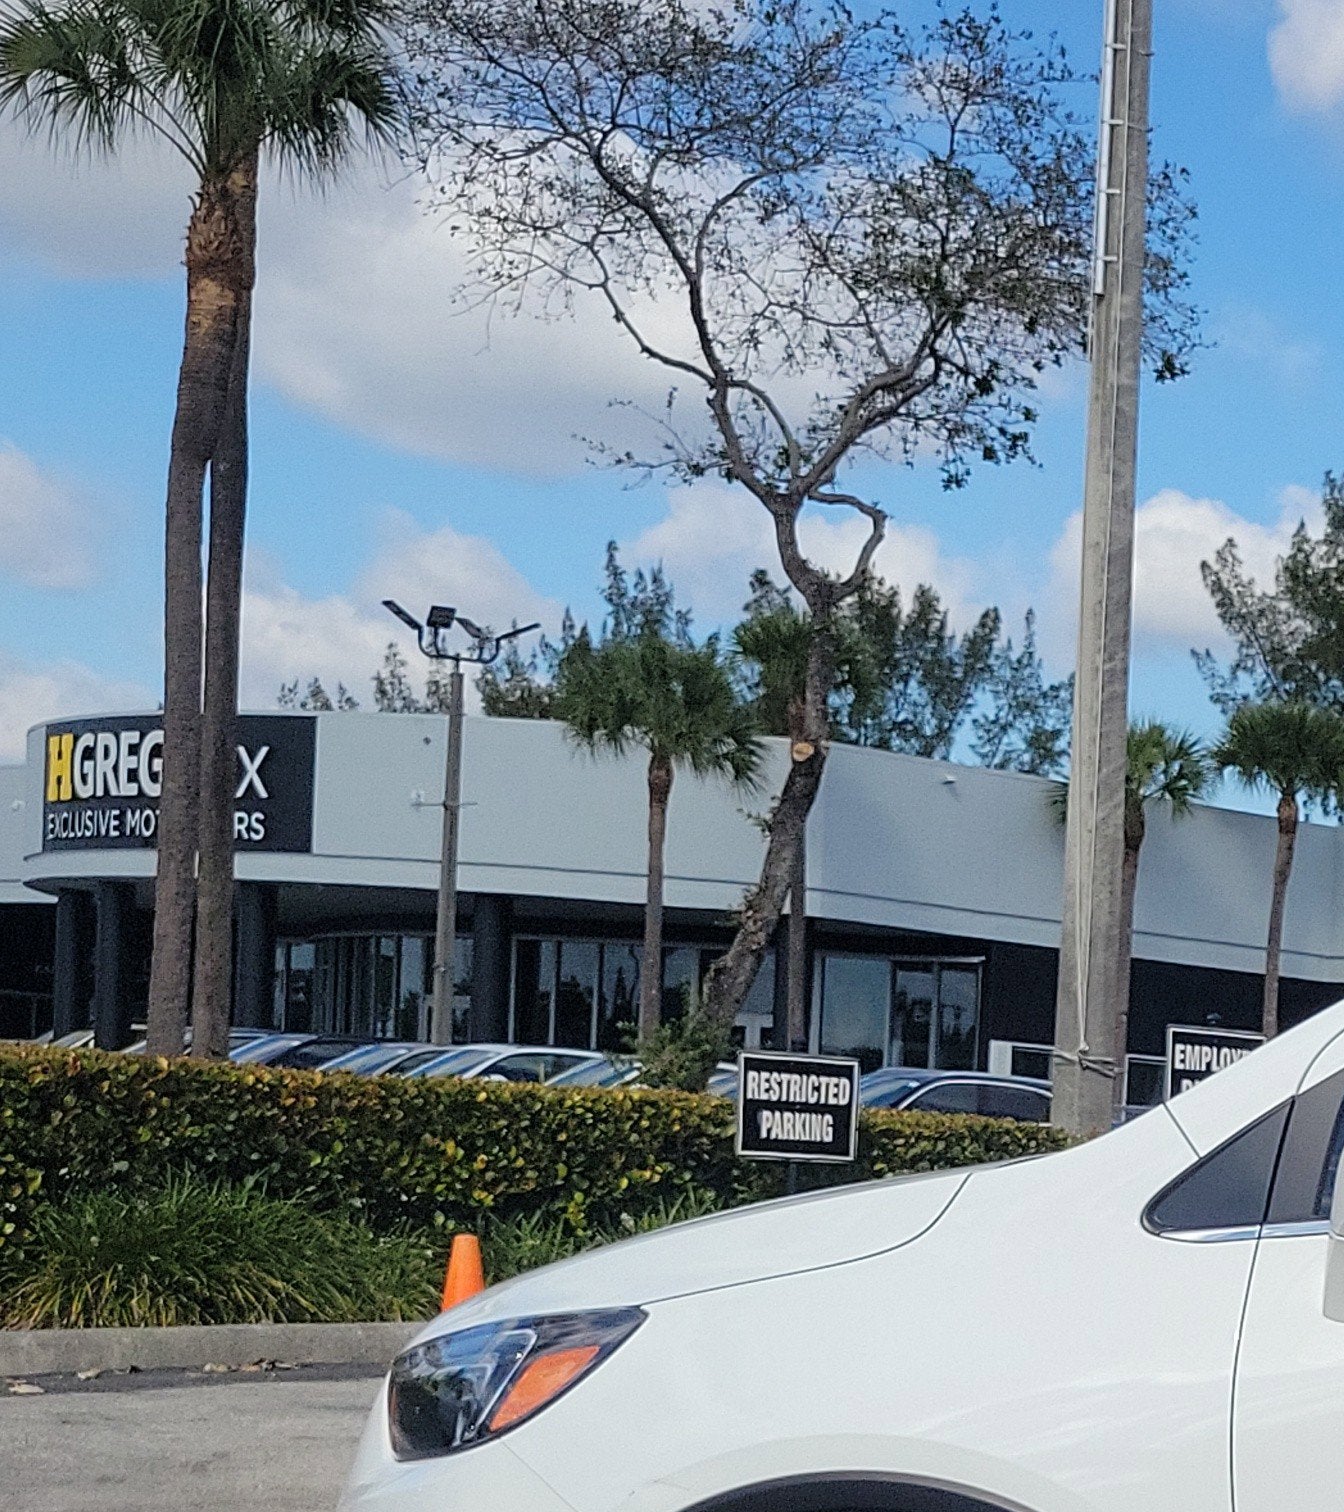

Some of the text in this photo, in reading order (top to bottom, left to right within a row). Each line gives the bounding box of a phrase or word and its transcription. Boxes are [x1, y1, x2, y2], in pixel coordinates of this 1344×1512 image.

[45, 808, 266, 841] EXCLUSIVE MORS
[746, 1069, 851, 1106] RESTRICTED
[760, 1109, 834, 1143] PARKING
